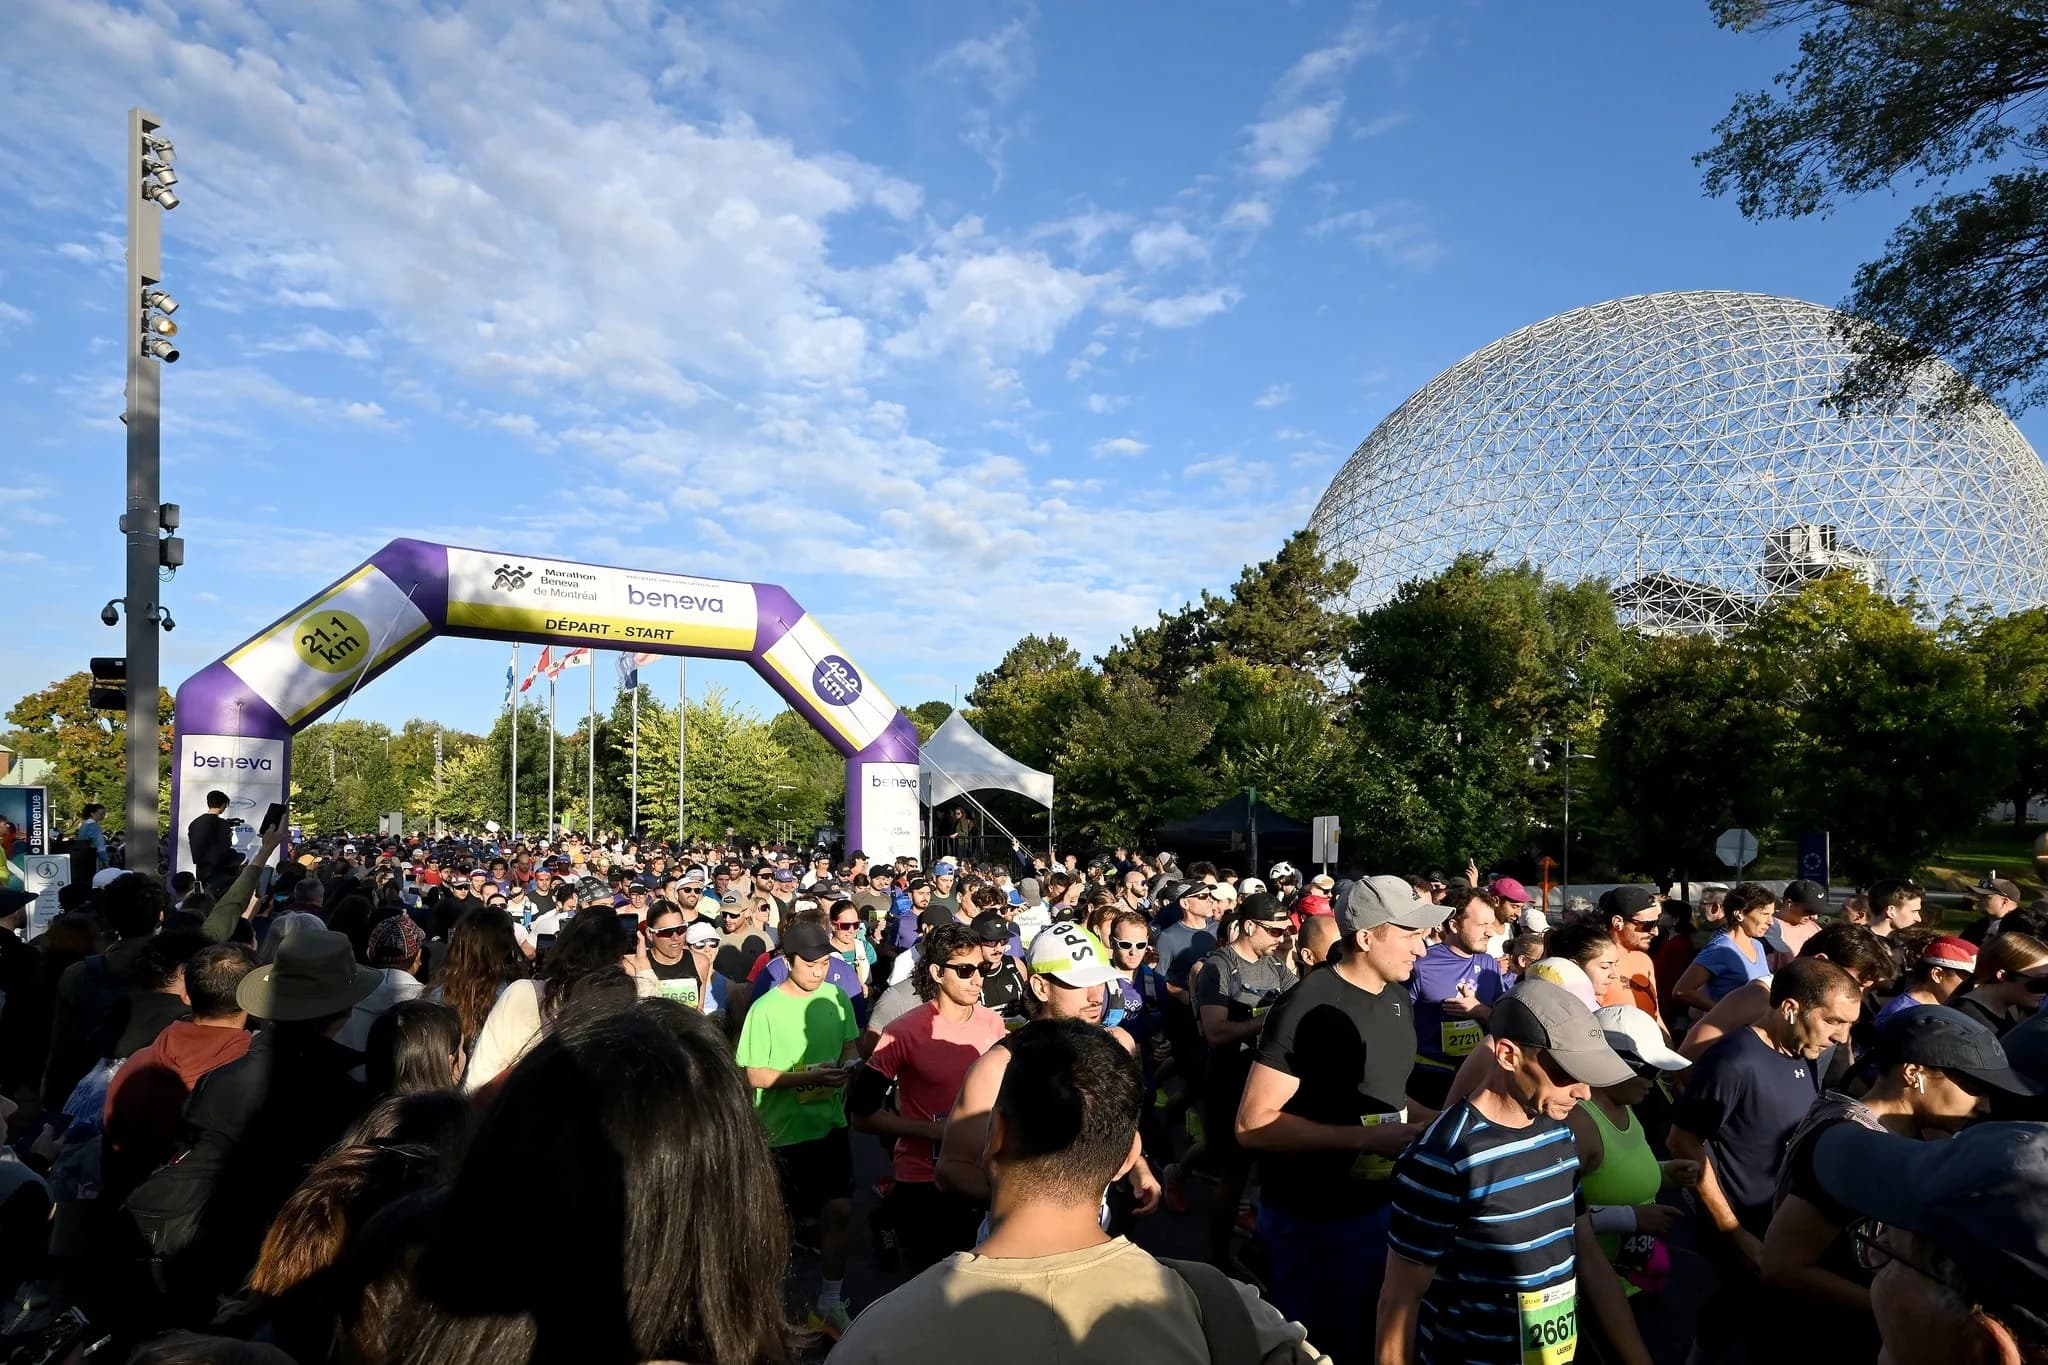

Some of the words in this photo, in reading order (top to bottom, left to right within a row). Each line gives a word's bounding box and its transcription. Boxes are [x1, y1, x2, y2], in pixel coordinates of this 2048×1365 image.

[540, 576, 579, 588] Beneva
[545, 568, 597, 581] Marathon
[533, 586, 547, 596] de
[550, 588, 597, 601] Montréal
[628, 584, 723, 613] beneva
[301, 616, 348, 654] 21.1
[545, 617, 611, 634] DÉPART
[625, 626, 675, 640] START
[318, 636, 361, 665] km
[819, 670, 845, 701] km
[829, 662, 858, 693] 42.2
[193, 751, 272, 771] beneva
[872, 775, 917, 788] beneva
[30, 795, 41, 846] Bienvenue
[1449, 1032, 1480, 1047] 27211
